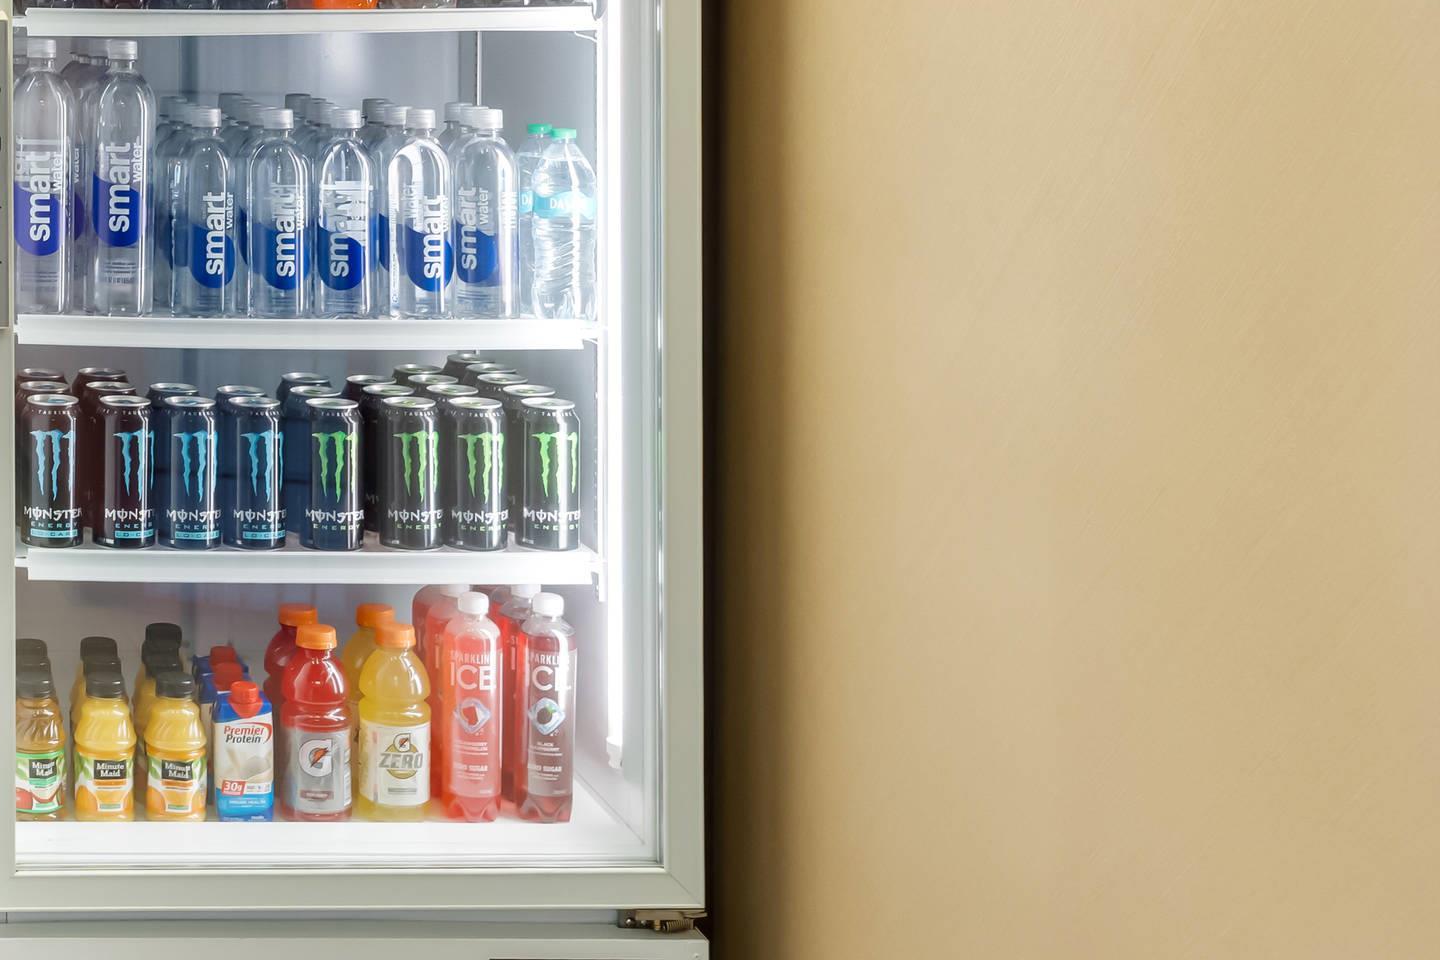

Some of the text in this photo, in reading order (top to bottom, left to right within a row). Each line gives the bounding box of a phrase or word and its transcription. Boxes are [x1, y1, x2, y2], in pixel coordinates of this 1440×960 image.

[106, 141, 143, 234] smart water
[29, 151, 51, 242] smart
[203, 191, 234, 275] smart water
[276, 192, 296, 278] smart
[458, 186, 489, 270] smart water
[423, 194, 443, 279] smart
[23, 505, 82, 521] MONSTER
[223, 725, 265, 736] Premier
[225, 734, 262, 744] Protein
[97, 762, 126, 772] Minute
[379, 751, 424, 769] ZERO
[35, 768, 54, 777] Maid
[100, 769, 122, 778] Maid
[168, 769, 190, 779] Maid
[223, 781, 243, 792] 30g
